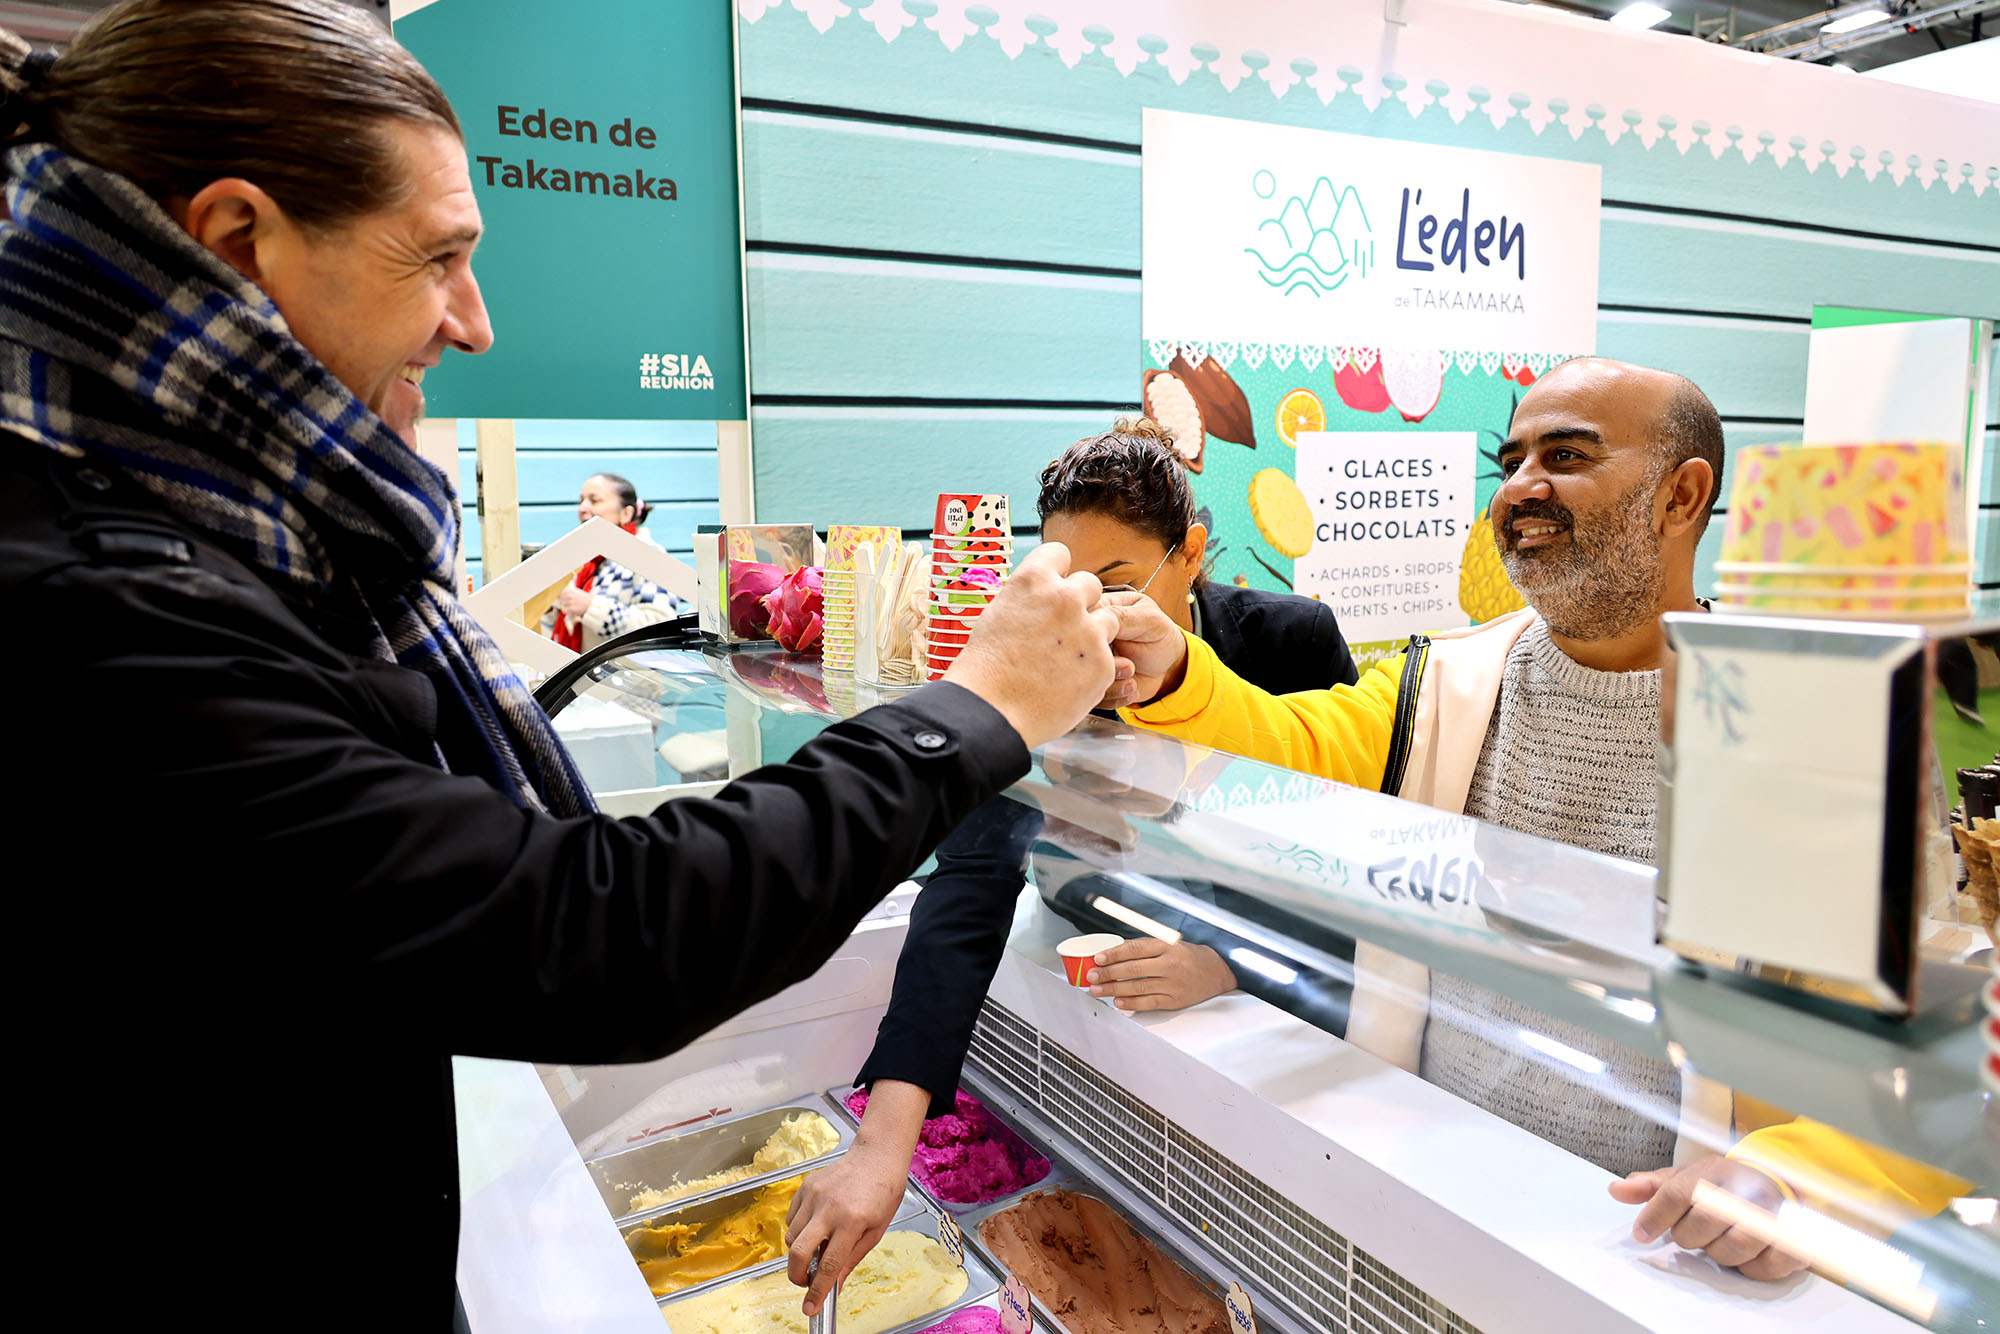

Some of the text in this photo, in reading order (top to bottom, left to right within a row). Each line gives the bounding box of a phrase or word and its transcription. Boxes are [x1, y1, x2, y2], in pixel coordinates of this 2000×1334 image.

[498, 105, 657, 149] Eden de
[476, 155, 678, 201] Takamaka
[1396, 187, 1525, 281] L'eden
[1394, 288, 1525, 314] de TAKAMAKA
[640, 354, 712, 377] #SIA
[640, 376, 714, 390] REUNION
[1344, 459, 1433, 479] GLACES
[1336, 489, 1439, 510] SORBETS
[1316, 519, 1456, 542] CHOCOLATS
[1320, 562, 1454, 581] ACHARDS SIROPS
[1341, 582, 1430, 599] CONFITURES
[1335, 599, 1444, 618] IMENTS CHIPS
